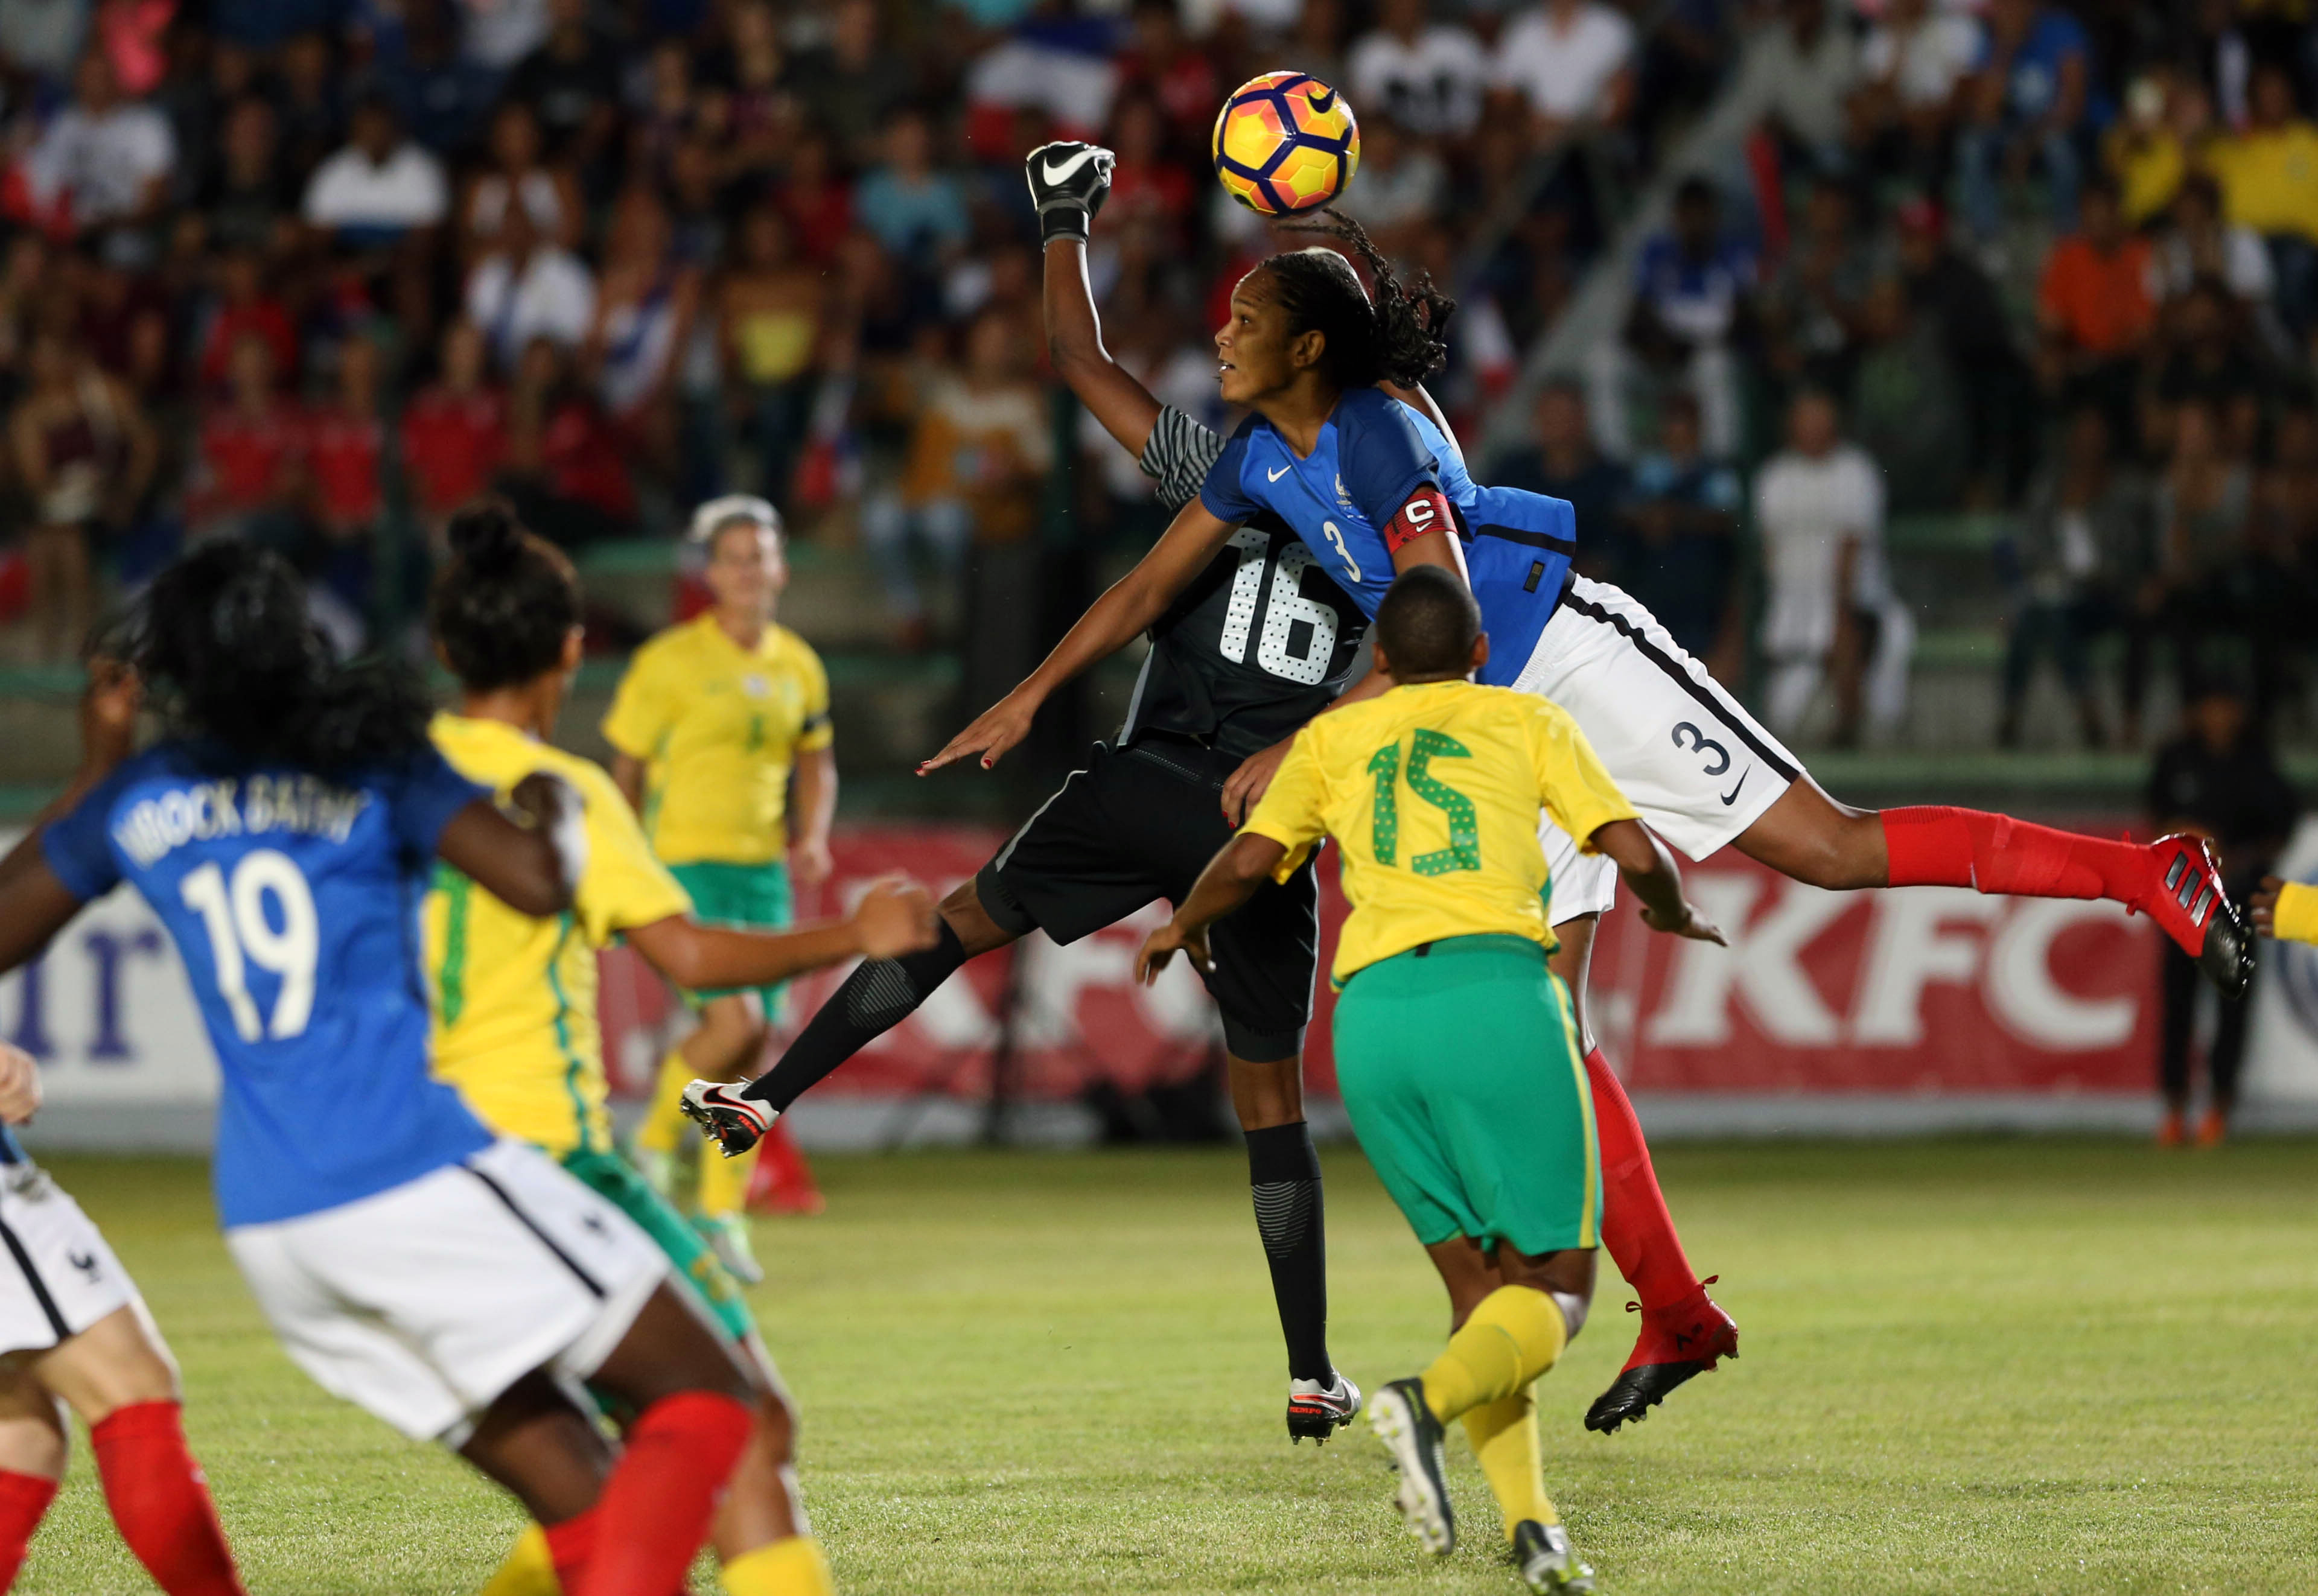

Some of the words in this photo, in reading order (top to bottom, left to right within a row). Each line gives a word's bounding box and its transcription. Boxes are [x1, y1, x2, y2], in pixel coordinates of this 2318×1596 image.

[1323, 521, 1361, 583] 3
[1405, 498, 1434, 524] C
[1219, 527, 1339, 685] 16
[1367, 728, 1482, 877] 15
[1672, 721, 1730, 775] 3
[180, 849, 319, 1043] 19
[1644, 869, 2139, 1052] KFC
